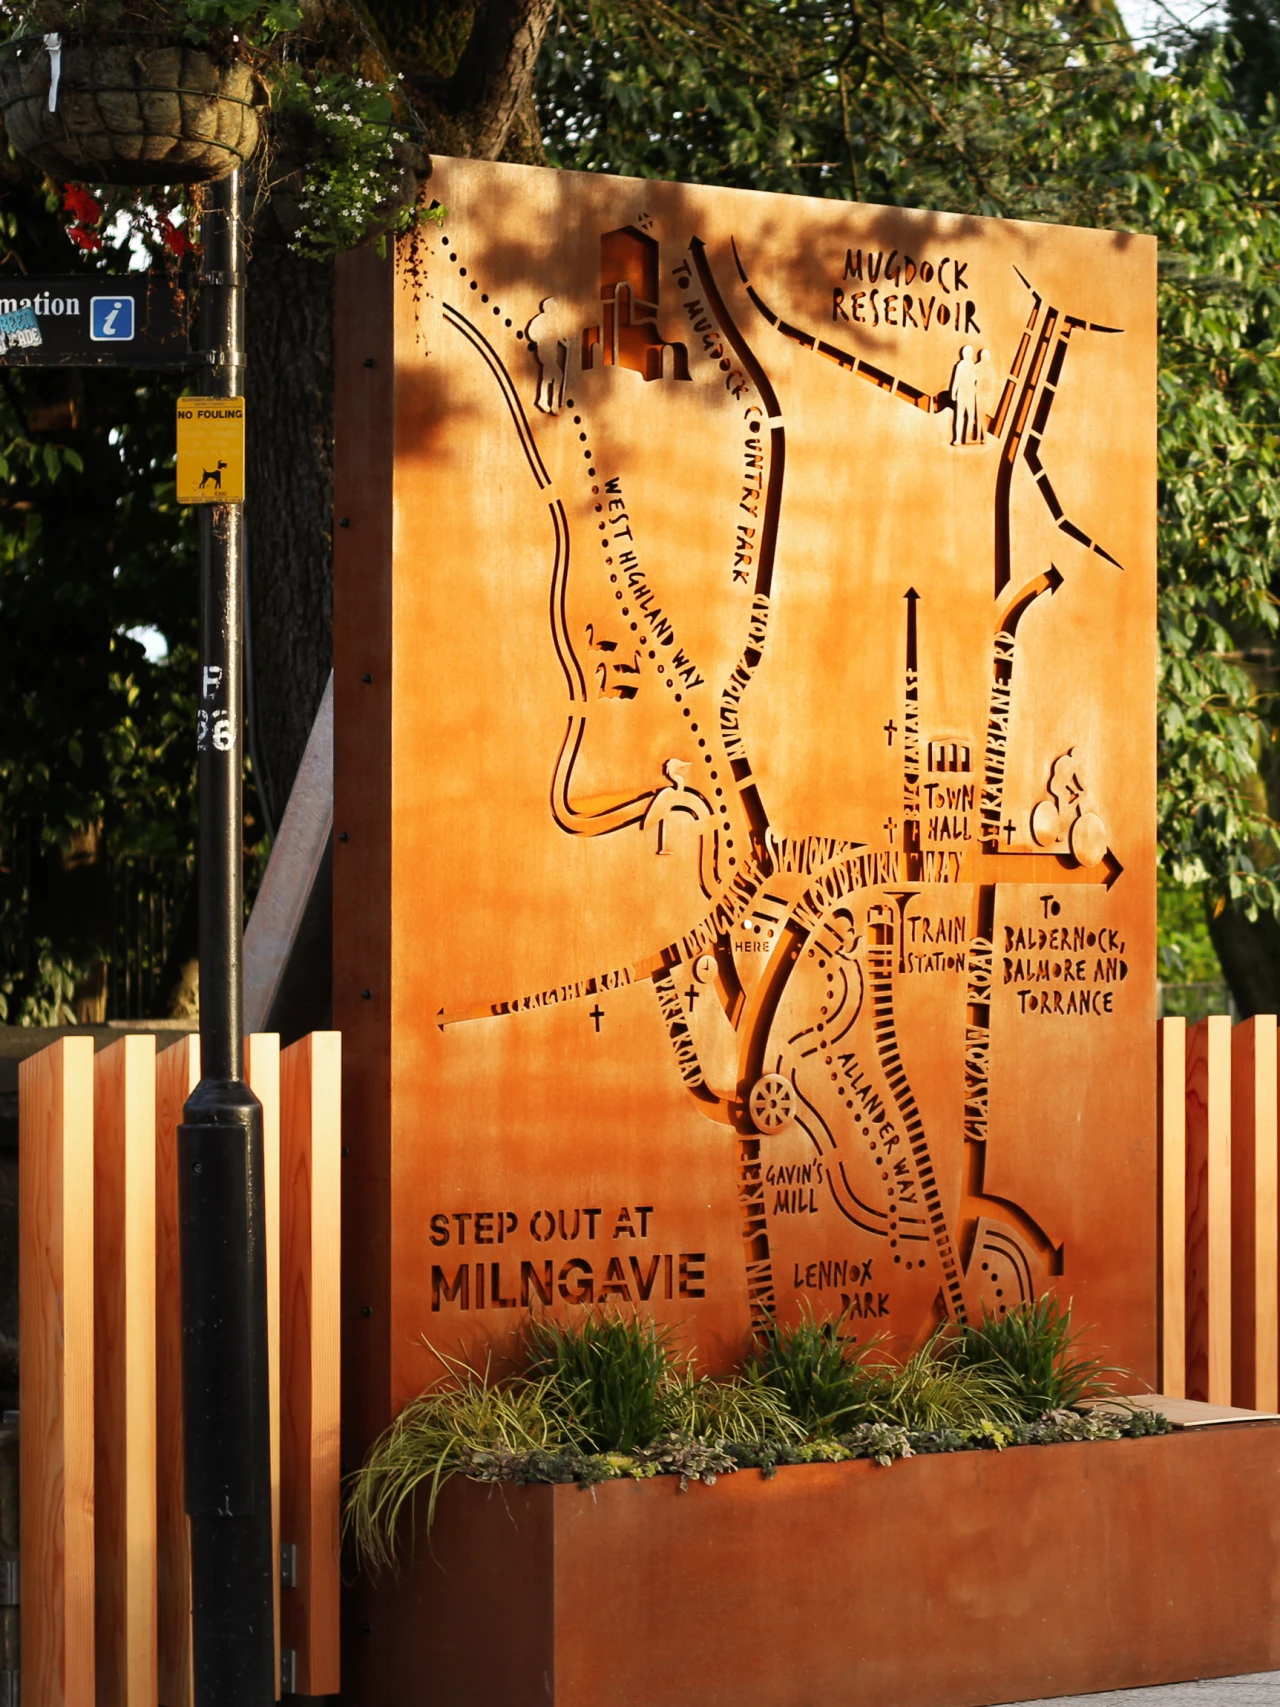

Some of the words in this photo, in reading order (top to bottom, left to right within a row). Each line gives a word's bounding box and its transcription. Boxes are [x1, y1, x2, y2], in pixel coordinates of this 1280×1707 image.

[671, 258, 693, 290] TO
[842, 248, 969, 294] MUGDOCK
[832, 287, 981, 334] RESERVOIR
[683, 299, 749, 401] MUGDOCK
[177, 410, 193, 419] NO
[197, 410, 243, 419] FOULING
[739, 405, 764, 519] COUNTRY
[604, 476, 634, 542] WEST
[732, 525, 756, 585] PARK
[618, 550, 674, 646] HIGHLAND
[994, 631, 1017, 662] RD
[672, 648, 705, 690] WAY
[720, 656, 757, 758] MUGDOCK
[747, 593, 771, 650] ROAD
[904, 700, 921, 821] BUCHANAN
[978, 677, 1013, 843] STRATHBLANE
[924, 782, 975, 813] TOWN
[928, 815, 972, 842] HALL
[765, 826, 832, 877] STATION
[791, 851, 899, 931] WOODBURN
[922, 850, 963, 883] WAY
[1040, 894, 1061, 919] TO
[735, 941, 770, 952] HERE
[907, 916, 966, 944] TRAIN
[1004, 925, 1125, 954] BALDERNOCK,
[908, 951, 966, 973] STATION
[968, 937, 995, 1003] ROAD
[1003, 957, 1087, 984] BALMORE
[1093, 957, 1129, 983] AND
[1017, 989, 1113, 1016] TORRANCE
[655, 976, 687, 1028] PARK
[671, 1031, 708, 1089] ROAD
[964, 1022, 991, 1141] GLASGOW
[837, 1052, 900, 1155] ALLANDER
[893, 1157, 918, 1204] WAY
[766, 1157, 824, 1186] GAVIN'S
[773, 1188, 819, 1216] MILL
[429, 1211, 519, 1247] STEP
[529, 1208, 602, 1243] OUT
[612, 1206, 654, 1239] AT
[431, 1252, 706, 1312] MILNGAVIE
[793, 1259, 873, 1291] LENNOX
[746, 1263, 776, 1338] MAIN
[840, 1292, 890, 1320] PARK
